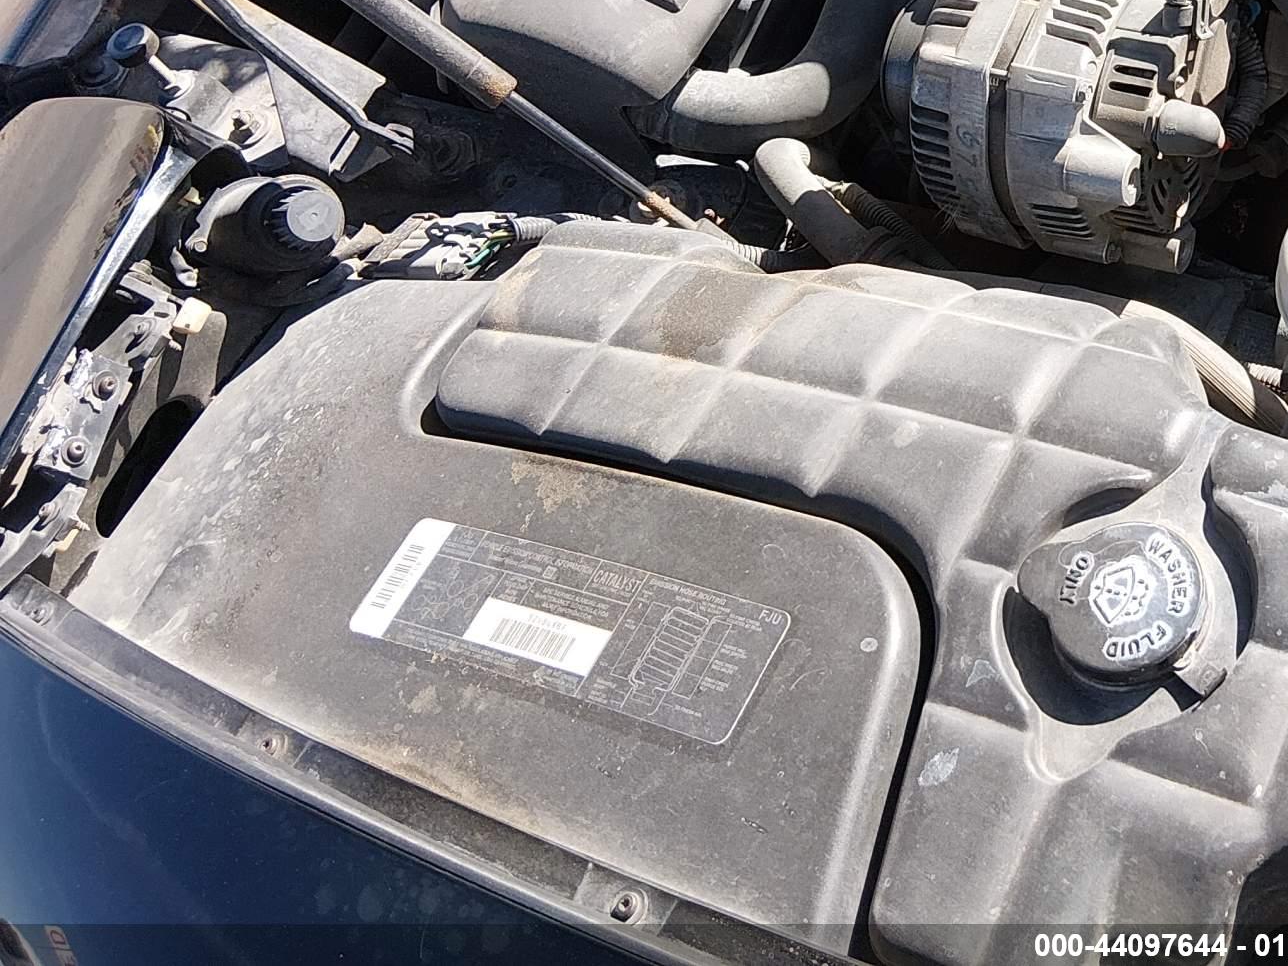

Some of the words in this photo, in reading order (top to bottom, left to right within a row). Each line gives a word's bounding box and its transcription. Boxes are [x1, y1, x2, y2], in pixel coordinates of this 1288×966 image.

[593, 569, 643, 594] CATALYST
[1060, 556, 1088, 604] ONLY
[1147, 537, 1188, 614] WASHER
[758, 609, 783, 626] FJU
[1106, 624, 1168, 658] FLUID
